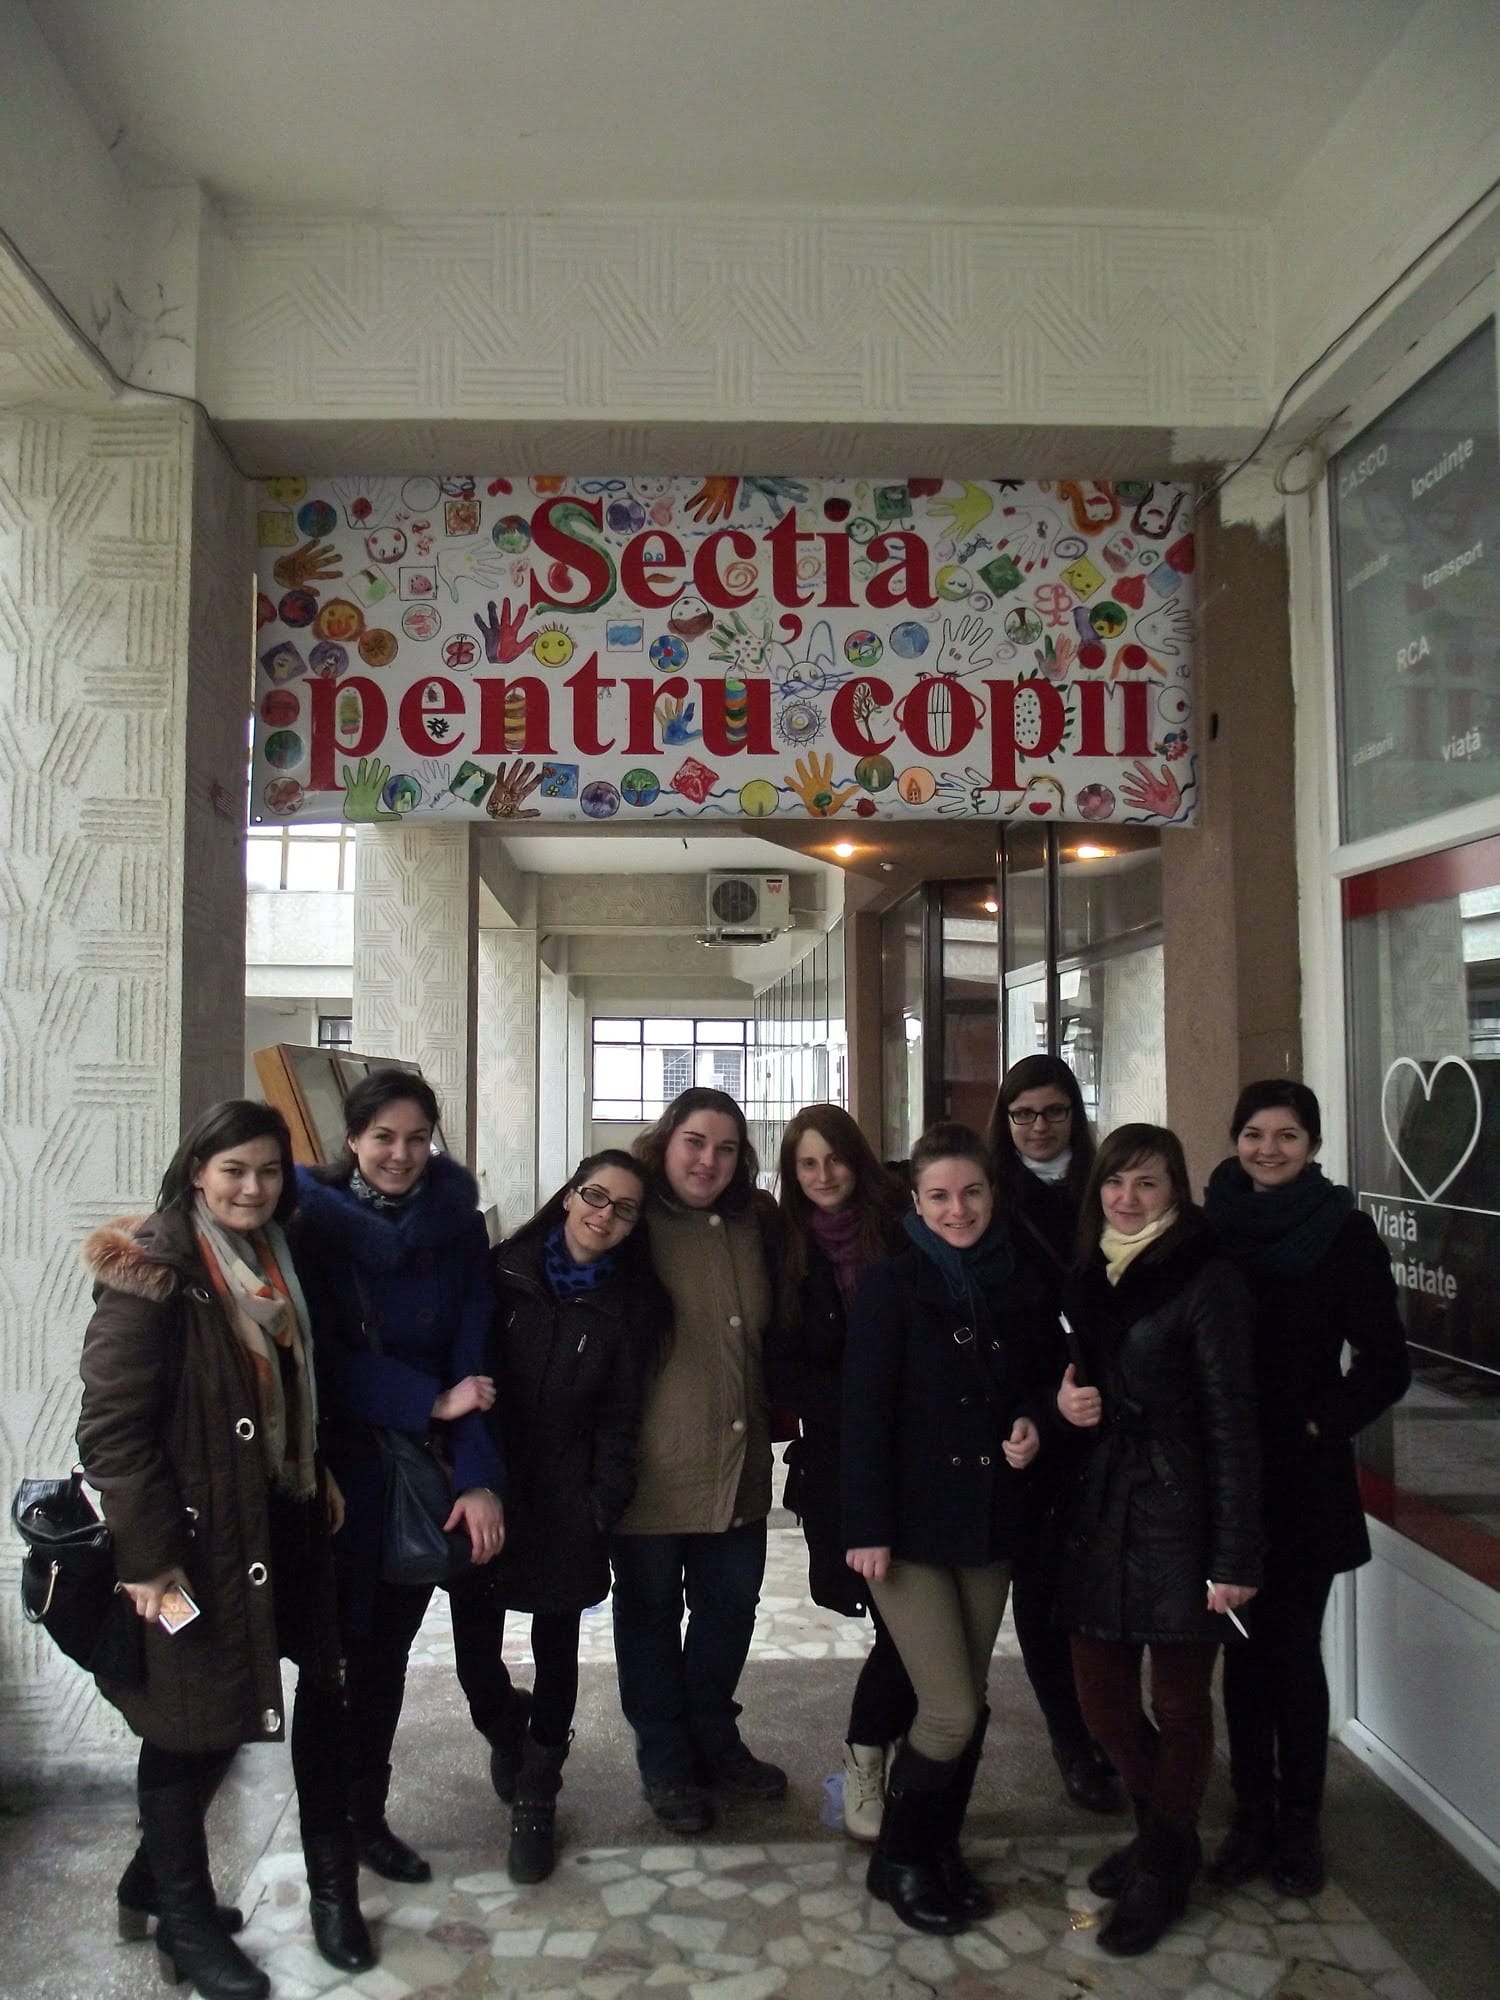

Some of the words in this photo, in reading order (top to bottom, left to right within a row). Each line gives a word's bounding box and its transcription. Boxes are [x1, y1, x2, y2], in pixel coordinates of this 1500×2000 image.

[1339, 444, 1387, 497] CASCO
[1411, 438, 1474, 500] locuințe
[530, 497, 938, 644] Secția
[1422, 540, 1483, 590] transport
[1396, 635, 1430, 672] RCA
[303, 651, 780, 791] pentru
[830, 644, 1157, 791] copii
[1441, 725, 1481, 762] viață
[1370, 1204, 1418, 1250] Viață
[1390, 1254, 1457, 1300] nătate
